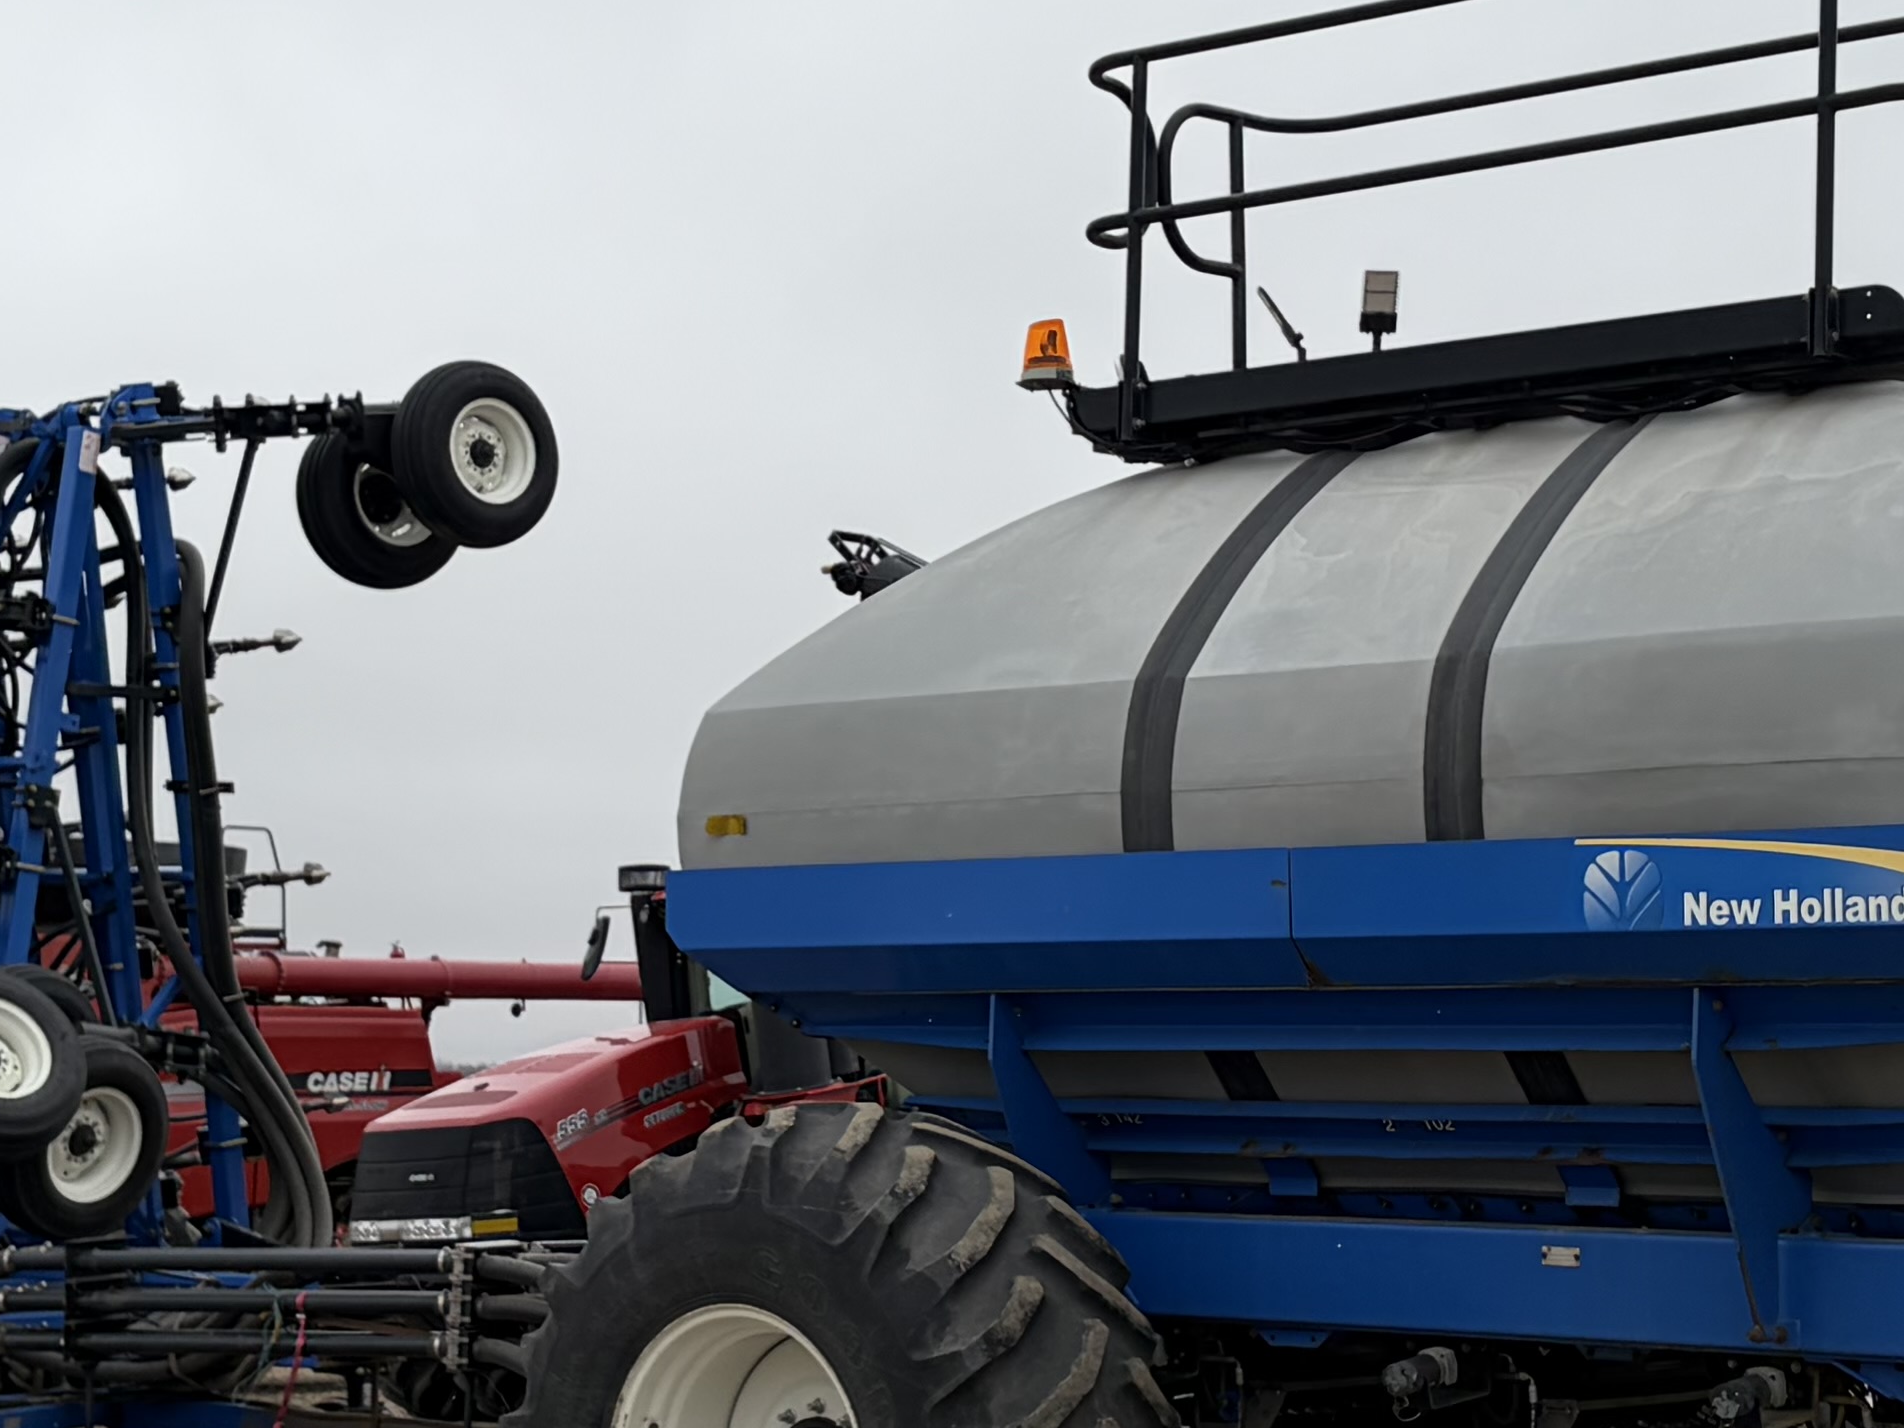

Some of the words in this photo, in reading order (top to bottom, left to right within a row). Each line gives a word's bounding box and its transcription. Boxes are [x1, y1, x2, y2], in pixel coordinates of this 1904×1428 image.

[1682, 890, 1762, 926] New
[307, 1071, 370, 1093] CASE
[638, 1073, 689, 1106] CASE
[1382, 1118, 1396, 1132] 2
